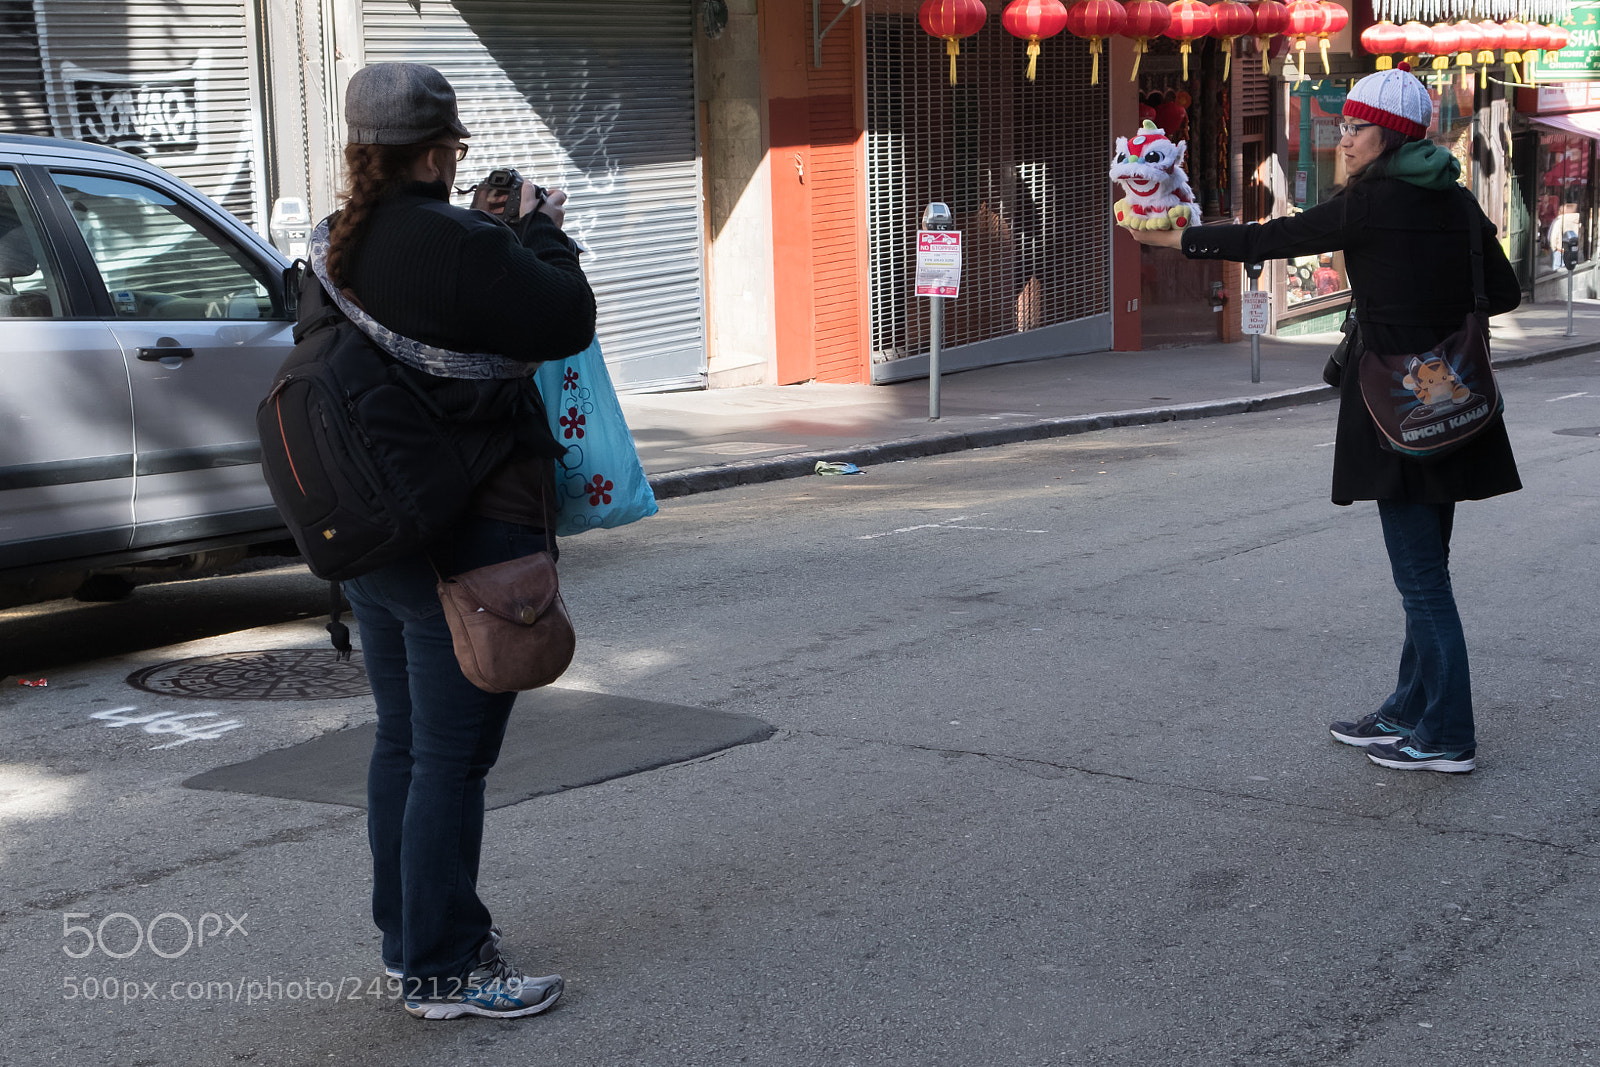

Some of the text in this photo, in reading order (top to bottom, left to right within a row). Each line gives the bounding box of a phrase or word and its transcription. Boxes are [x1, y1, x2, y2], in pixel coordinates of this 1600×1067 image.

[1549, 61, 1589, 69] ORIENTAL
[1402, 404, 1489, 443] KIMCHI KAWAII
